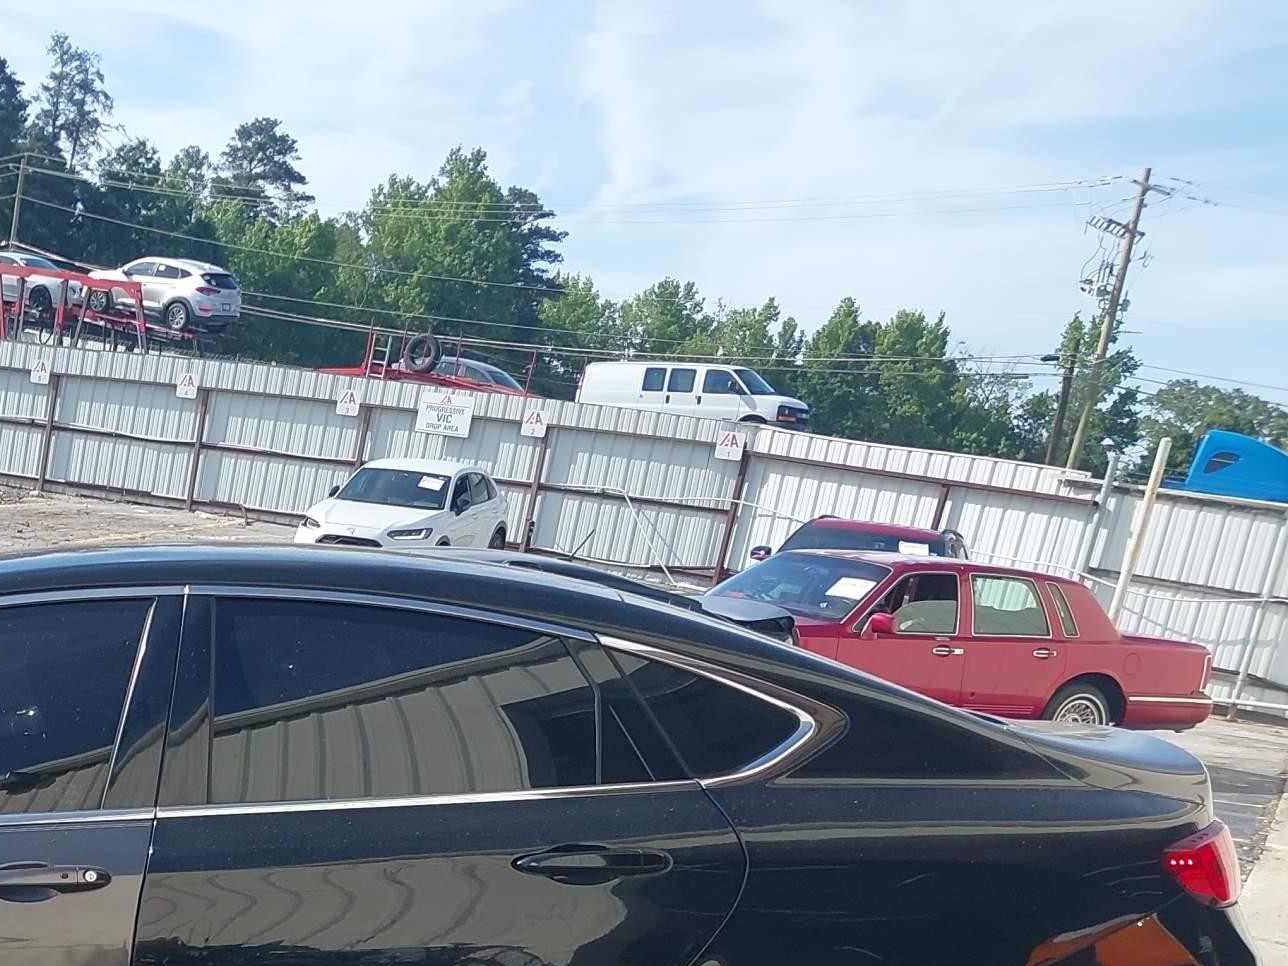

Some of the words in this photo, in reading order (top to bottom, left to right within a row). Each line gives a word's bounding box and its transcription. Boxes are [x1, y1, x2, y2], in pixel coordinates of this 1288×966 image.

[425, 404, 465, 416] PROGRESSIVE
[436, 413, 453, 424] VIC
[425, 422, 443, 430] DROP
[443, 425, 459, 433] AREA
